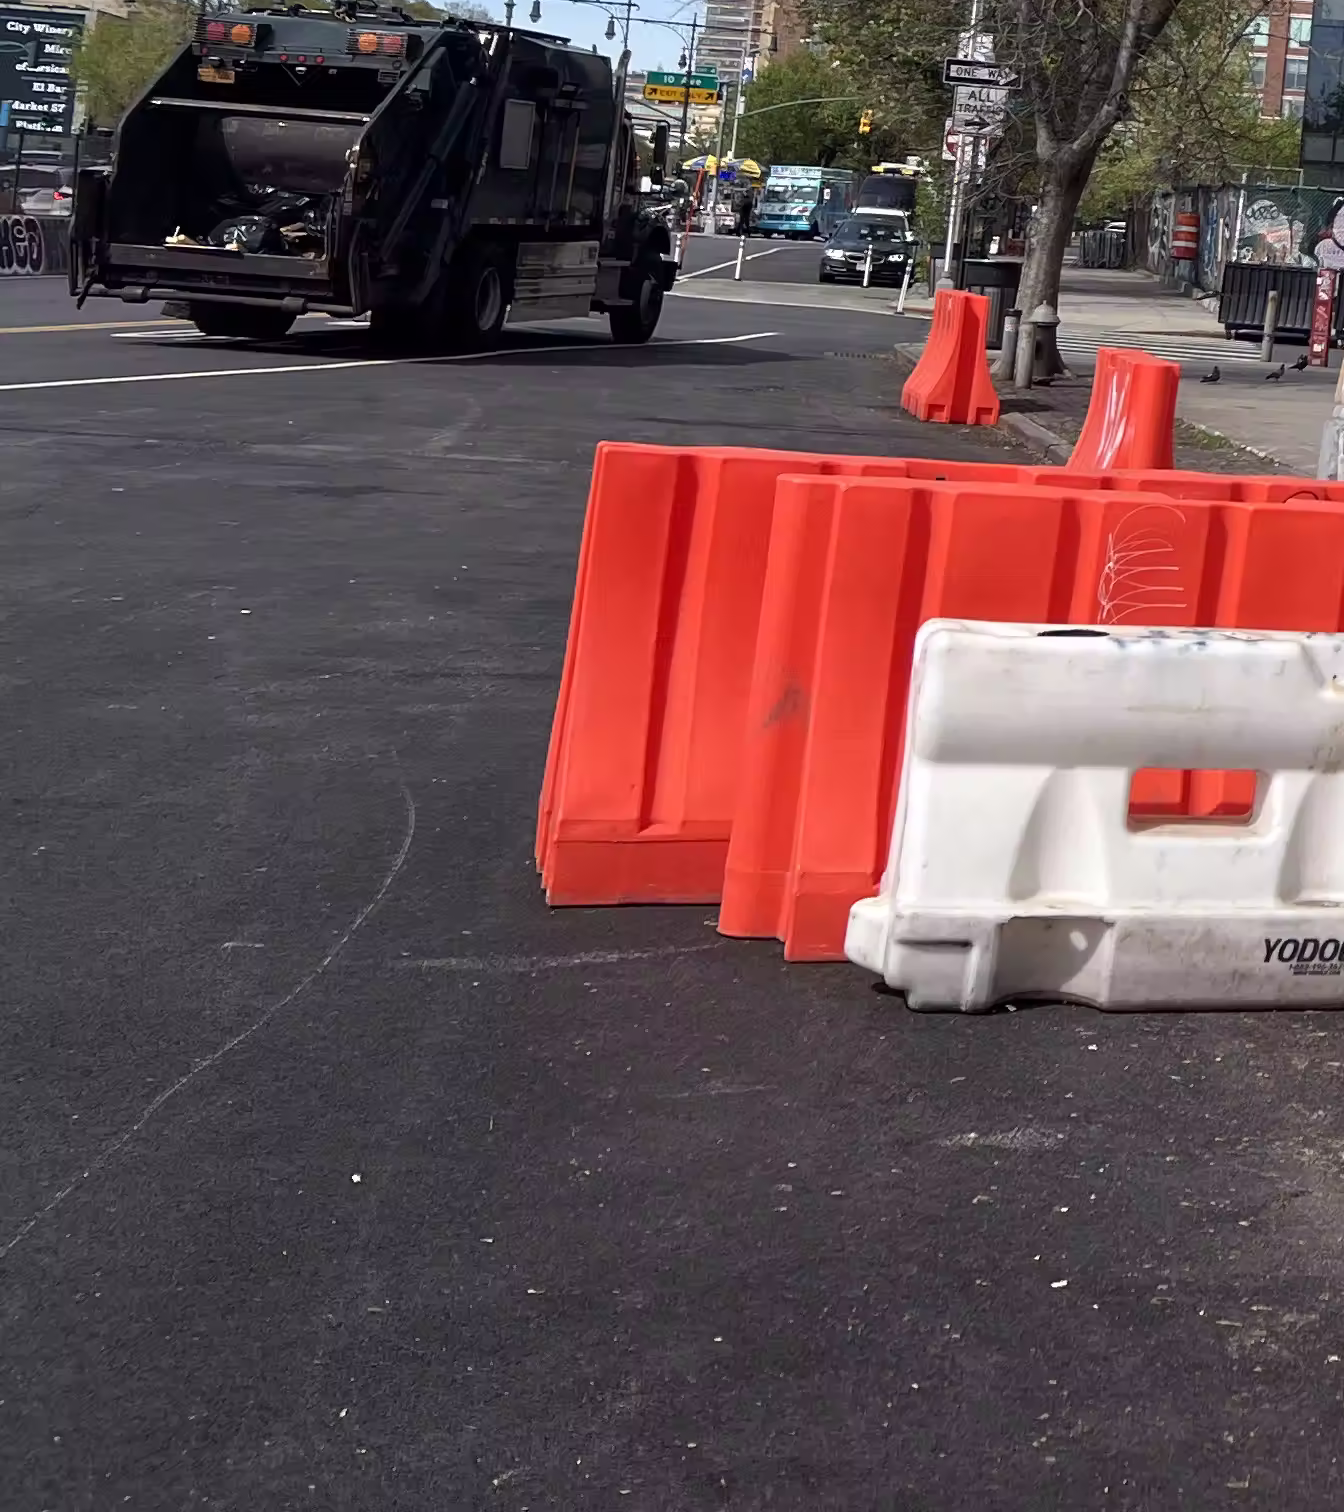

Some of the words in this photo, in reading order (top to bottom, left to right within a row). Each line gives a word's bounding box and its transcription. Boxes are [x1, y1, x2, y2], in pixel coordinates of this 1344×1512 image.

[6, 21, 31, 34] City
[956, 66, 978, 77] ONE
[663, 74, 675, 83] 10
[968, 90, 995, 103] ALL
[50, 103, 66, 113] 57
